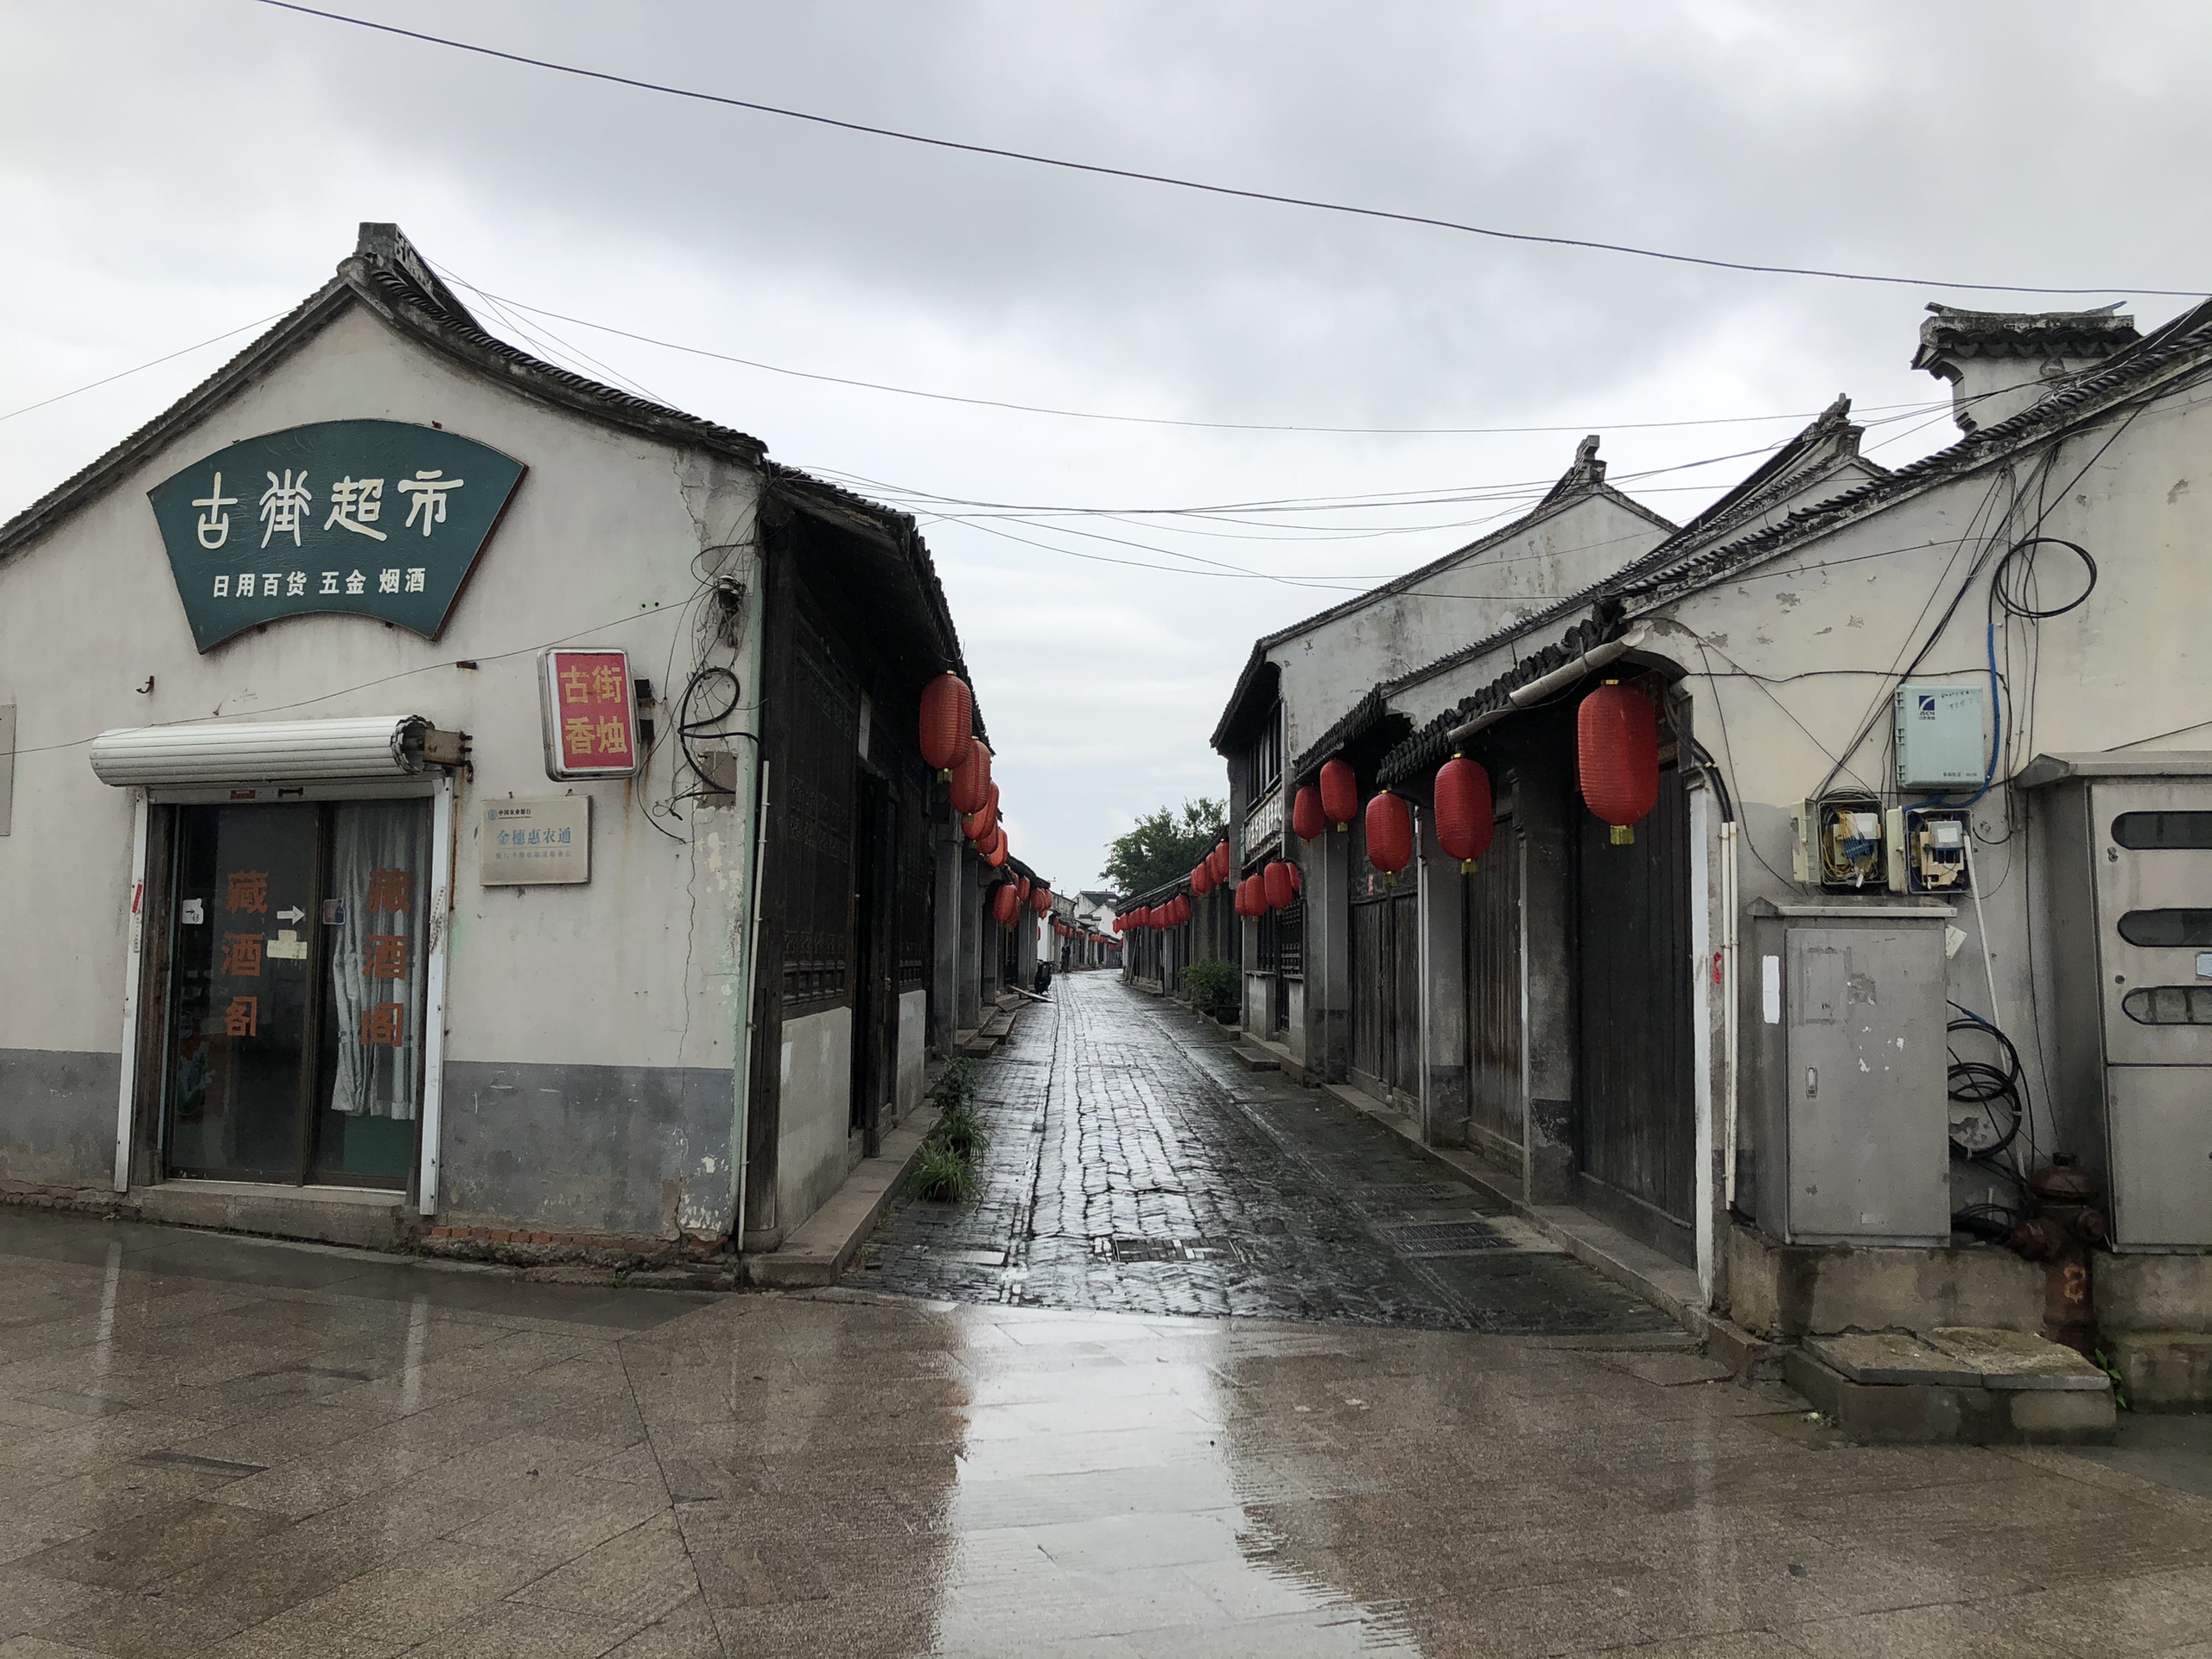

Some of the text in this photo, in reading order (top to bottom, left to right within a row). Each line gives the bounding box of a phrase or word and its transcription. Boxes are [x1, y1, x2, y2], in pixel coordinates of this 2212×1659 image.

[191, 467, 464, 550] 古街超市
[213, 567, 426, 598] 日用百货 五金 烟酒
[560, 664, 623, 704] 古街
[564, 715, 628, 754] 香烛
